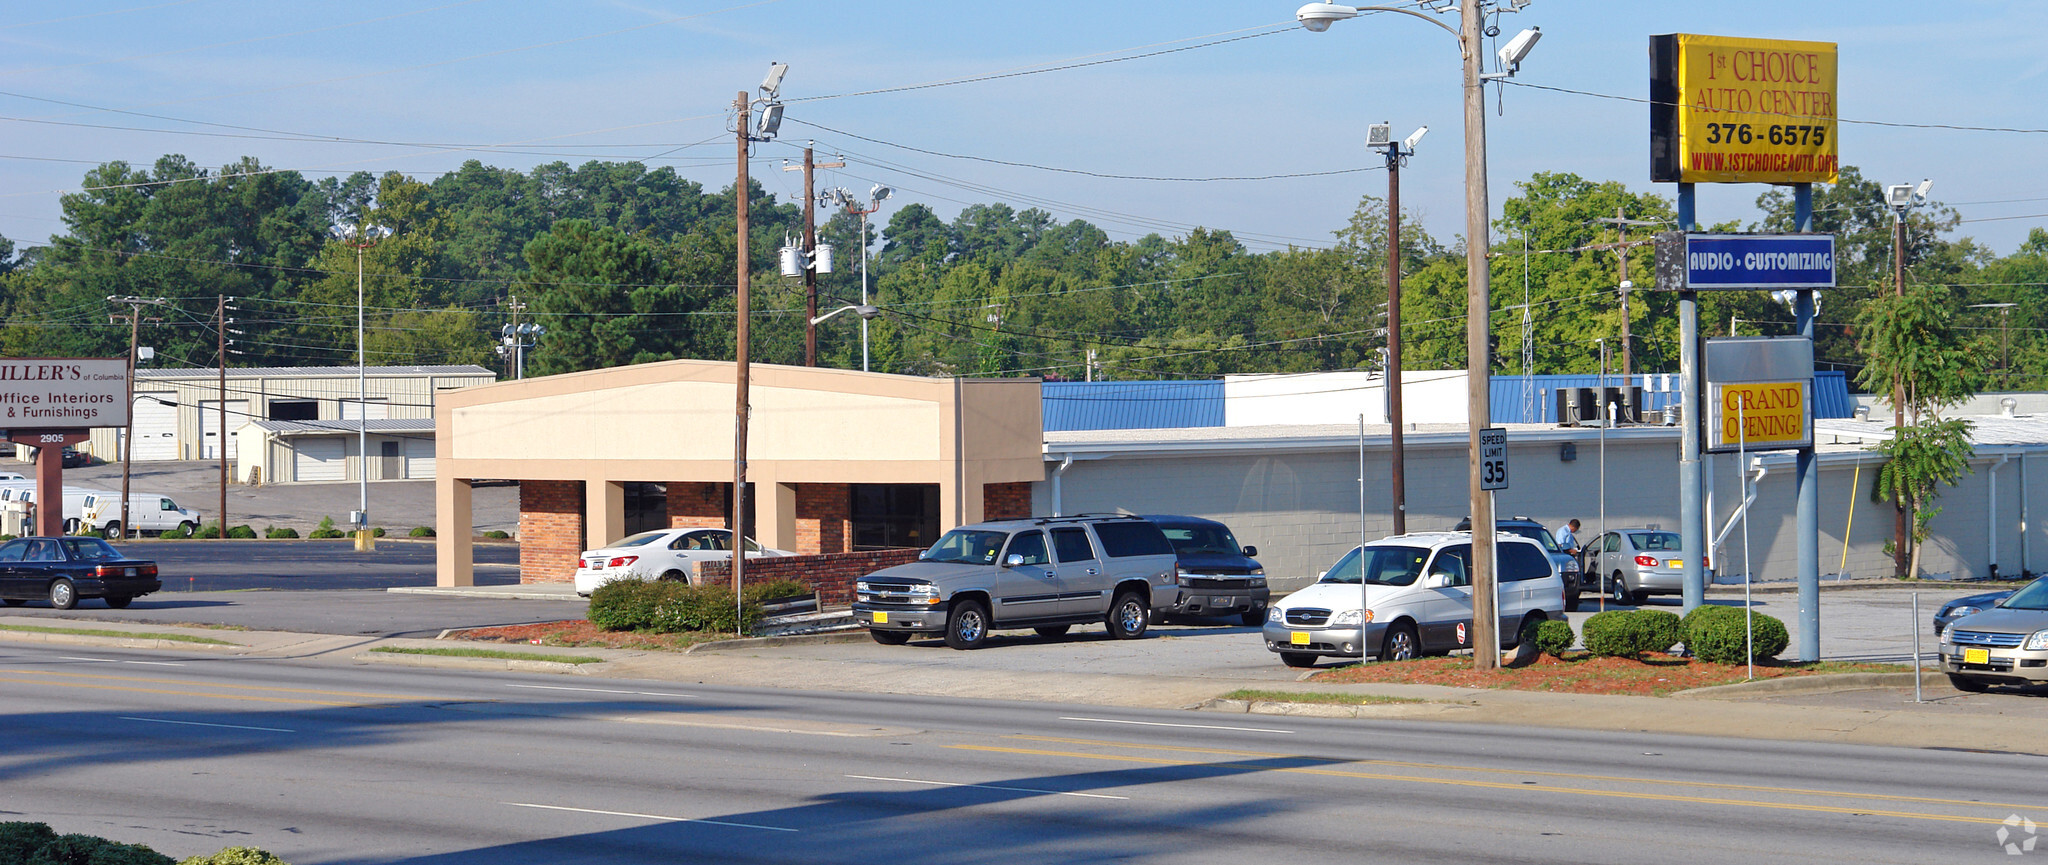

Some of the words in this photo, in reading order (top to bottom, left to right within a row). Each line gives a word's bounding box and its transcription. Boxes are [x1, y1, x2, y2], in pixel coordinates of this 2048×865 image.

[1708, 51, 1726, 80] 1st
[1733, 50, 1820, 84] CHOICE
[1694, 88, 1752, 113] AUTO
[1759, 89, 1833, 116] CENTER
[1691, 151, 1838, 173] WWW.1STCHOICEAUTO.ORG
[1690, 252, 1734, 270] AUDIO
[1744, 252, 1831, 271] CUSTOMIZING
[0, 364, 81, 381] ILLER'S
[93, 373, 124, 381] Columbia
[0, 392, 40, 404] ffice
[48, 392, 114, 404] Interiors
[1726, 388, 1800, 411] GRAND
[7, 406, 16, 418] &
[23, 406, 98, 420] Furnishings
[40, 433, 64, 443] 2905
[1481, 435, 1504, 445] SPEED
[1484, 447, 1502, 457] LIMIT
[1484, 461, 1505, 483] 35
